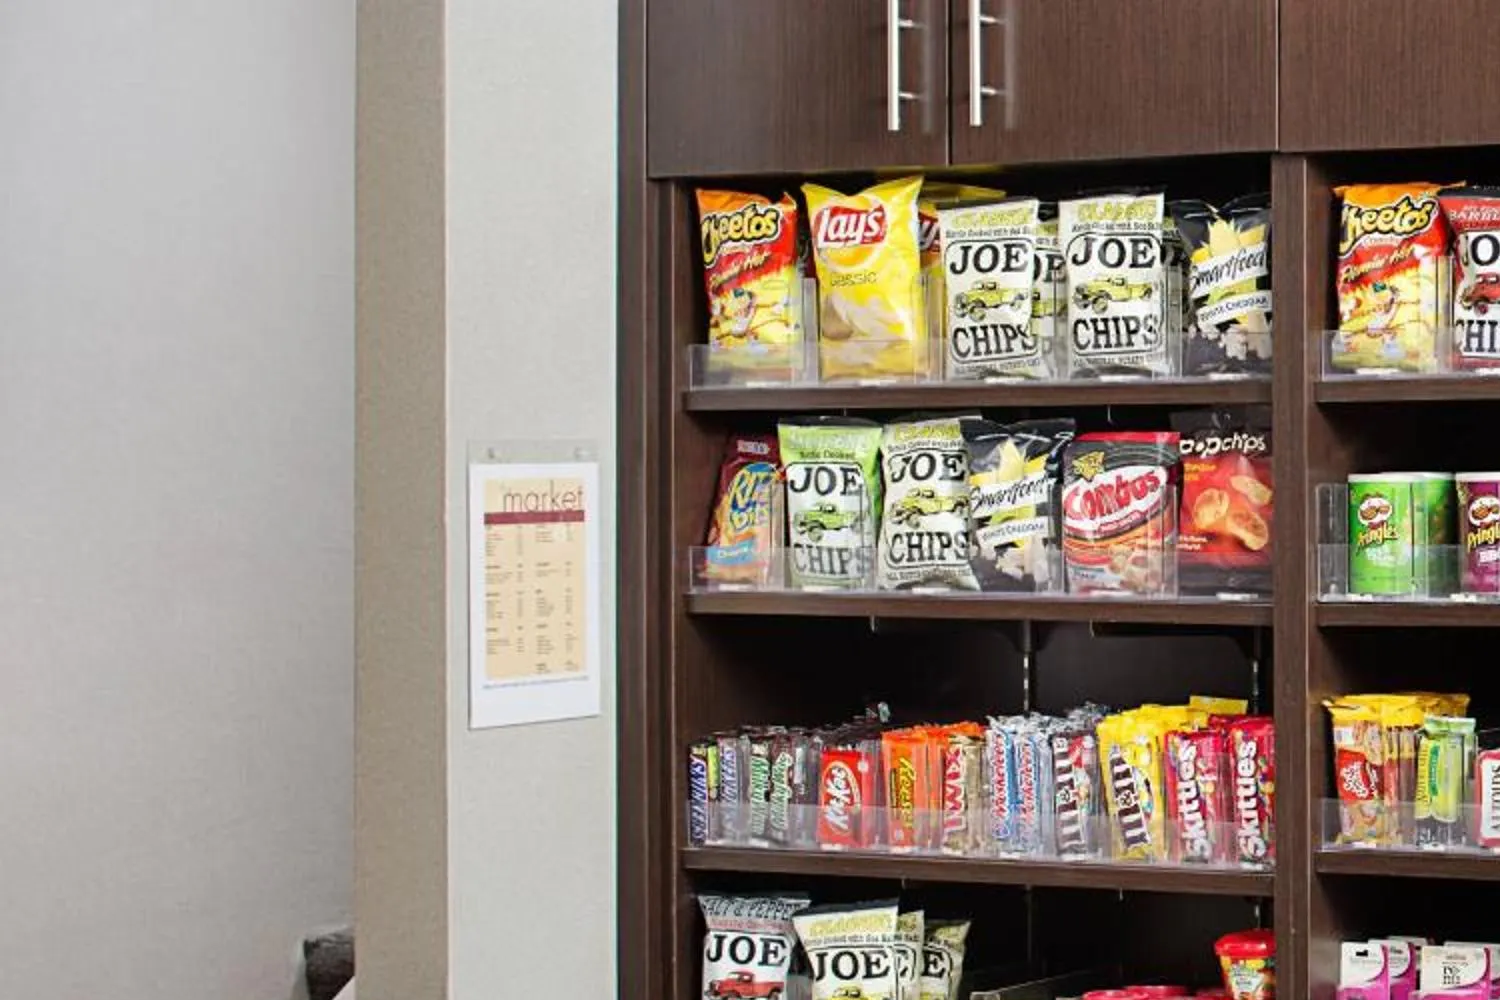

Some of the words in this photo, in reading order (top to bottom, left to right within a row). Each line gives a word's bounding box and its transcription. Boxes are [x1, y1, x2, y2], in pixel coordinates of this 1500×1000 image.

[950, 243, 1029, 275] JOE
[1071, 237, 1156, 269] JOE
[951, 322, 1038, 358] CHIPS
[1072, 314, 1160, 351] CHIPS
[502, 480, 584, 512] market
[789, 466, 862, 496] JOE
[1063, 471, 1161, 521] Combos
[794, 543, 874, 576] CHIPS
[890, 530, 970, 566] CHIPS
[1236, 739, 1266, 857] Skittles
[706, 934, 786, 967] JOE
[815, 951, 891, 982] JOE
